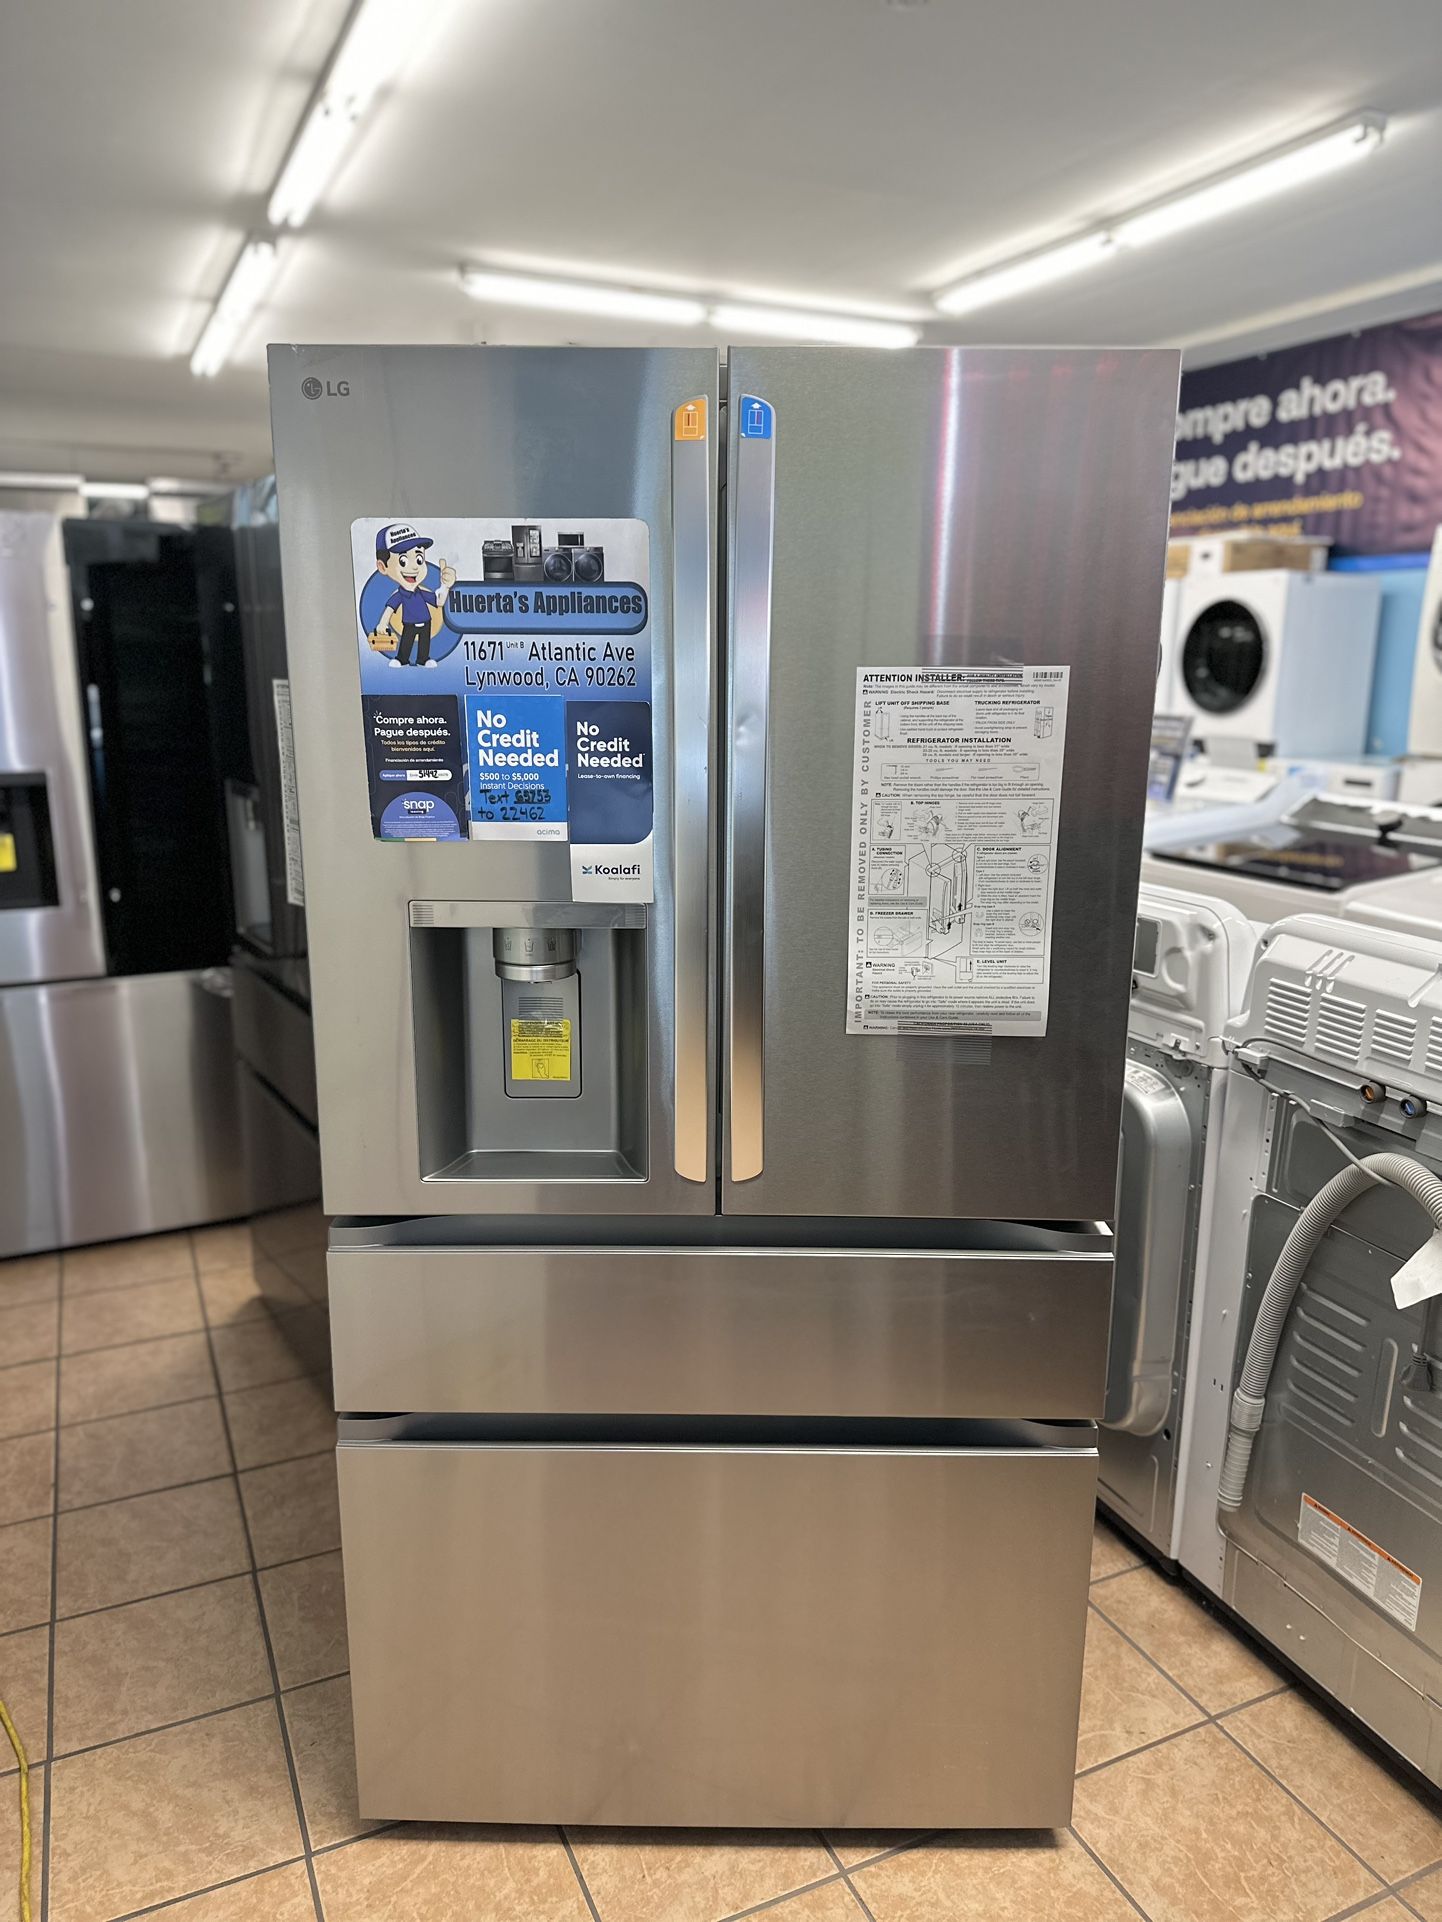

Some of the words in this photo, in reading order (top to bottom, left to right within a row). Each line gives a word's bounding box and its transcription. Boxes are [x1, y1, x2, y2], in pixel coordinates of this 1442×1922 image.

[327, 381, 350, 397] LG
[1276, 371, 1397, 423] ahora.
[1232, 421, 1401, 485] después.
[450, 591, 530, 613] Huerta's
[533, 591, 643, 616] Appliances
[463, 641, 504, 661] 11671
[528, 640, 597, 661] Atlantic
[602, 641, 635, 661] Ave
[465, 666, 550, 691] Lynwood,
[555, 667, 580, 687] CA
[585, 667, 637, 687] 90262
[863, 674, 913, 682] ATTENTION
[915, 673, 966, 682] INSTALLER:
[376, 715, 415, 726] Compre
[416, 715, 447, 724] ahora.
[476, 710, 507, 728] No
[374, 727, 404, 738] Pague
[406, 727, 451, 738] después.
[576, 721, 600, 736] No
[861, 701, 872, 772] CUSTOMER
[477, 729, 540, 748] Credit
[576, 737, 630, 752] Credit
[478, 749, 559, 767] Needed
[577, 753, 643, 768] Needed
[480, 772, 500, 781] $500
[502, 773, 510, 781] to
[511, 772, 539, 782] $5,000
[480, 782, 506, 790] Instant
[507, 782, 545, 790] Decisions
[860, 779, 868, 796] BY
[479, 789, 510, 805] Text
[403, 800, 435, 812] snap
[478, 806, 495, 820] to
[500, 806, 546, 820] 22462
[859, 803, 868, 834] ONLY
[536, 828, 561, 836] acima
[595, 864, 641, 875] Koalafi
[857, 842, 867, 900] REMOVED
[857, 907, 865, 922] BE
[856, 928, 864, 943] TO
[854, 950, 865, 1023] IMPORTANT:
